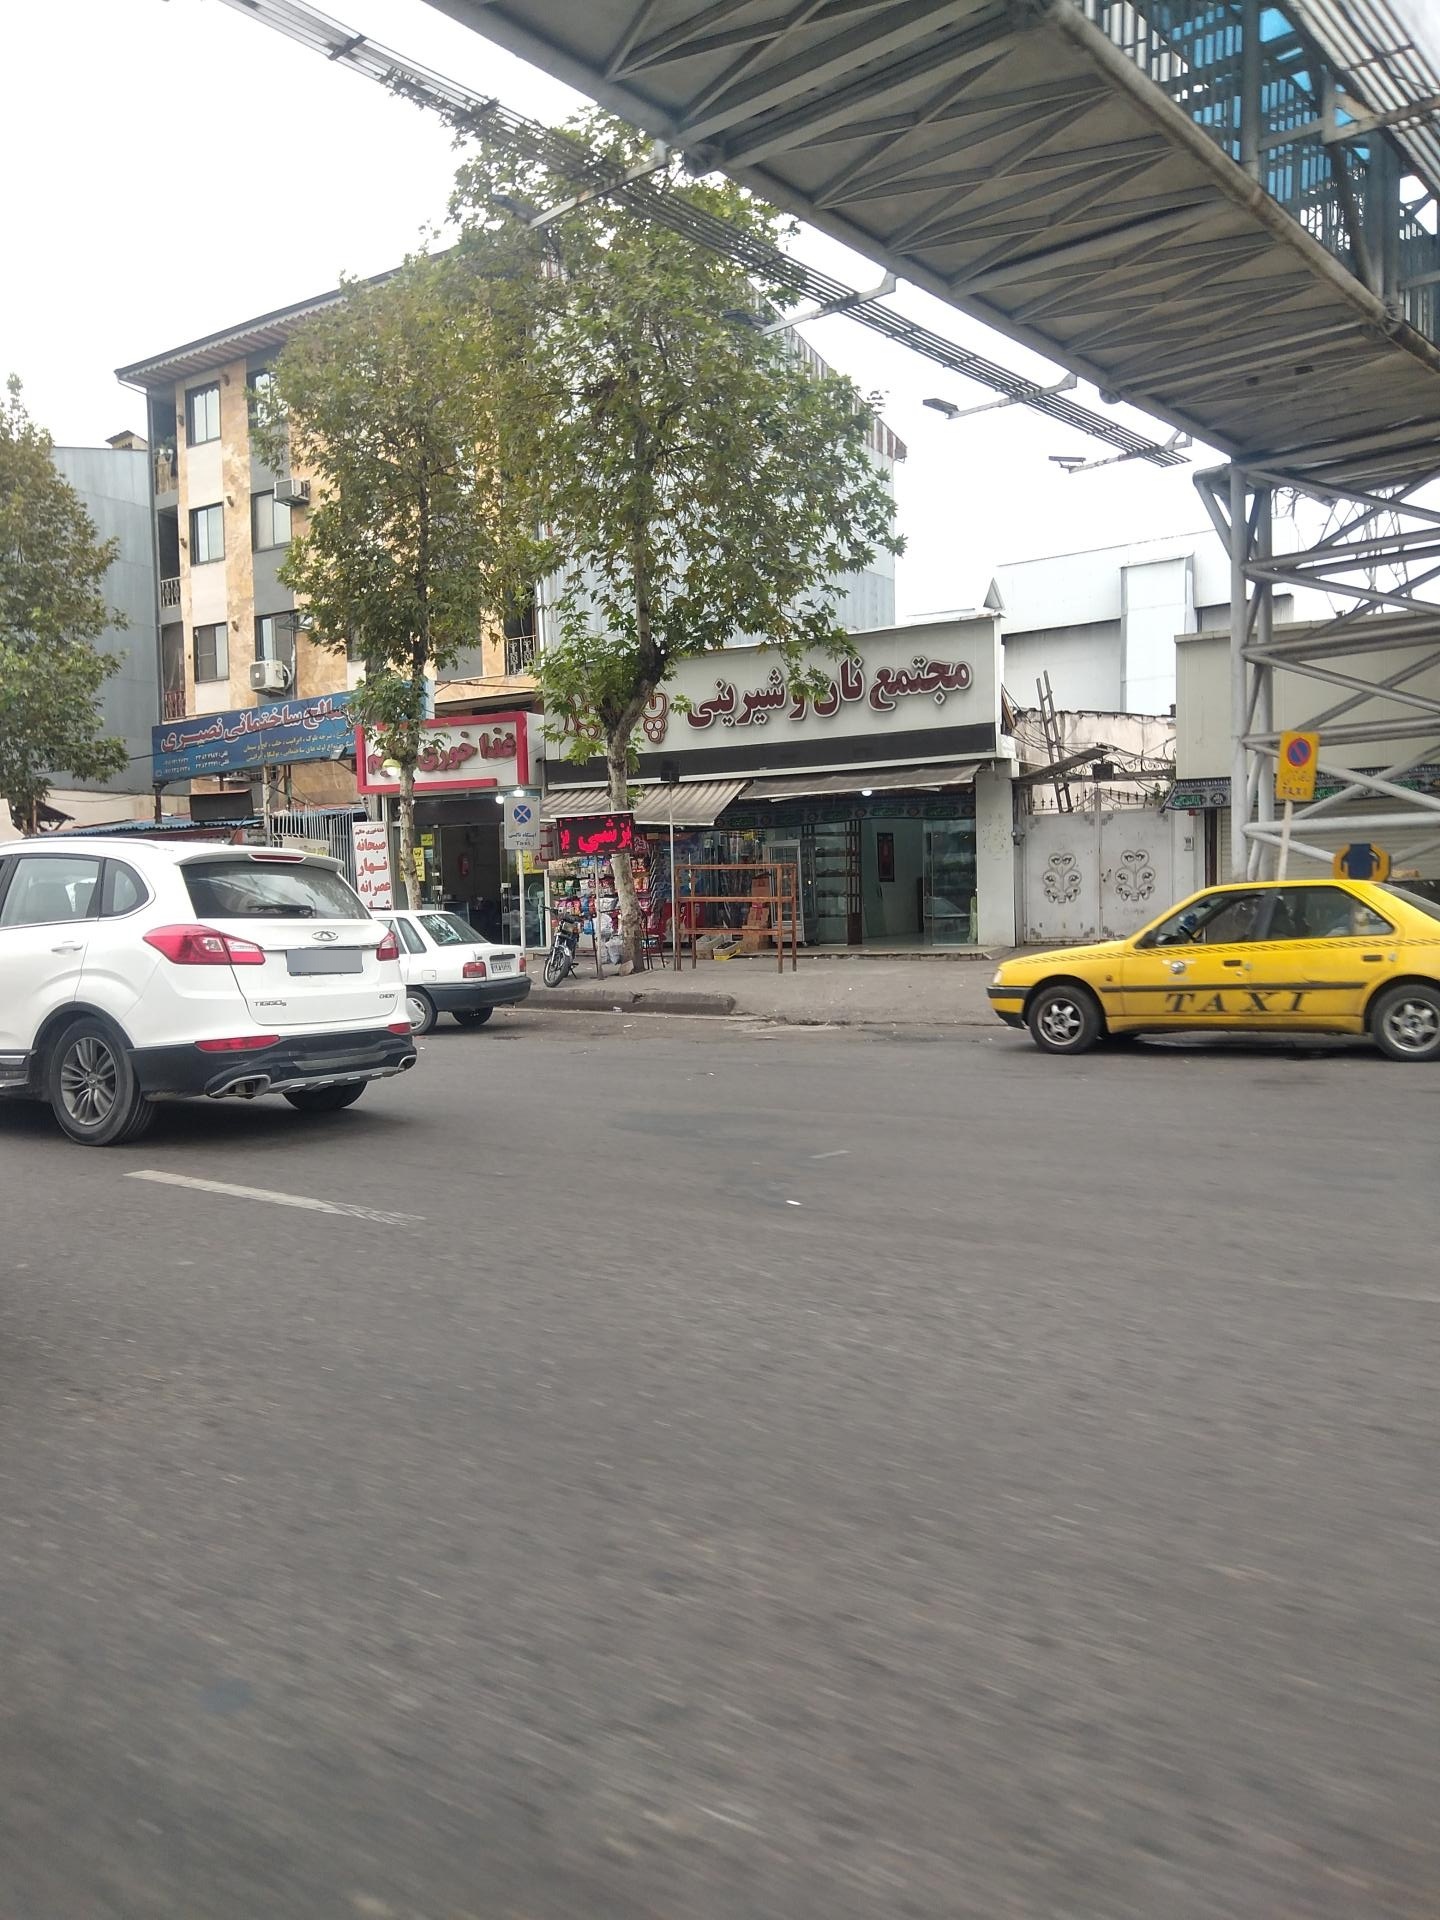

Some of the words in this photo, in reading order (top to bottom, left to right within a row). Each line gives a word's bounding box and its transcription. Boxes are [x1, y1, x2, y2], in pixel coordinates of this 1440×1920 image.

[687, 667, 787, 729] شیرینی
[812, 656, 865, 718] نان
[868, 656, 972, 711] مجتمع
[160, 717, 224, 753] نصیری
[223, 704, 302, 743] ساختمانی
[416, 731, 478, 772] خوری
[479, 727, 517, 759] غذا
[356, 838, 386, 854] صبحانه
[357, 855, 388, 877] نهار
[359, 880, 391, 897] عصرانه
[1165, 991, 1312, 1013] TAXI
